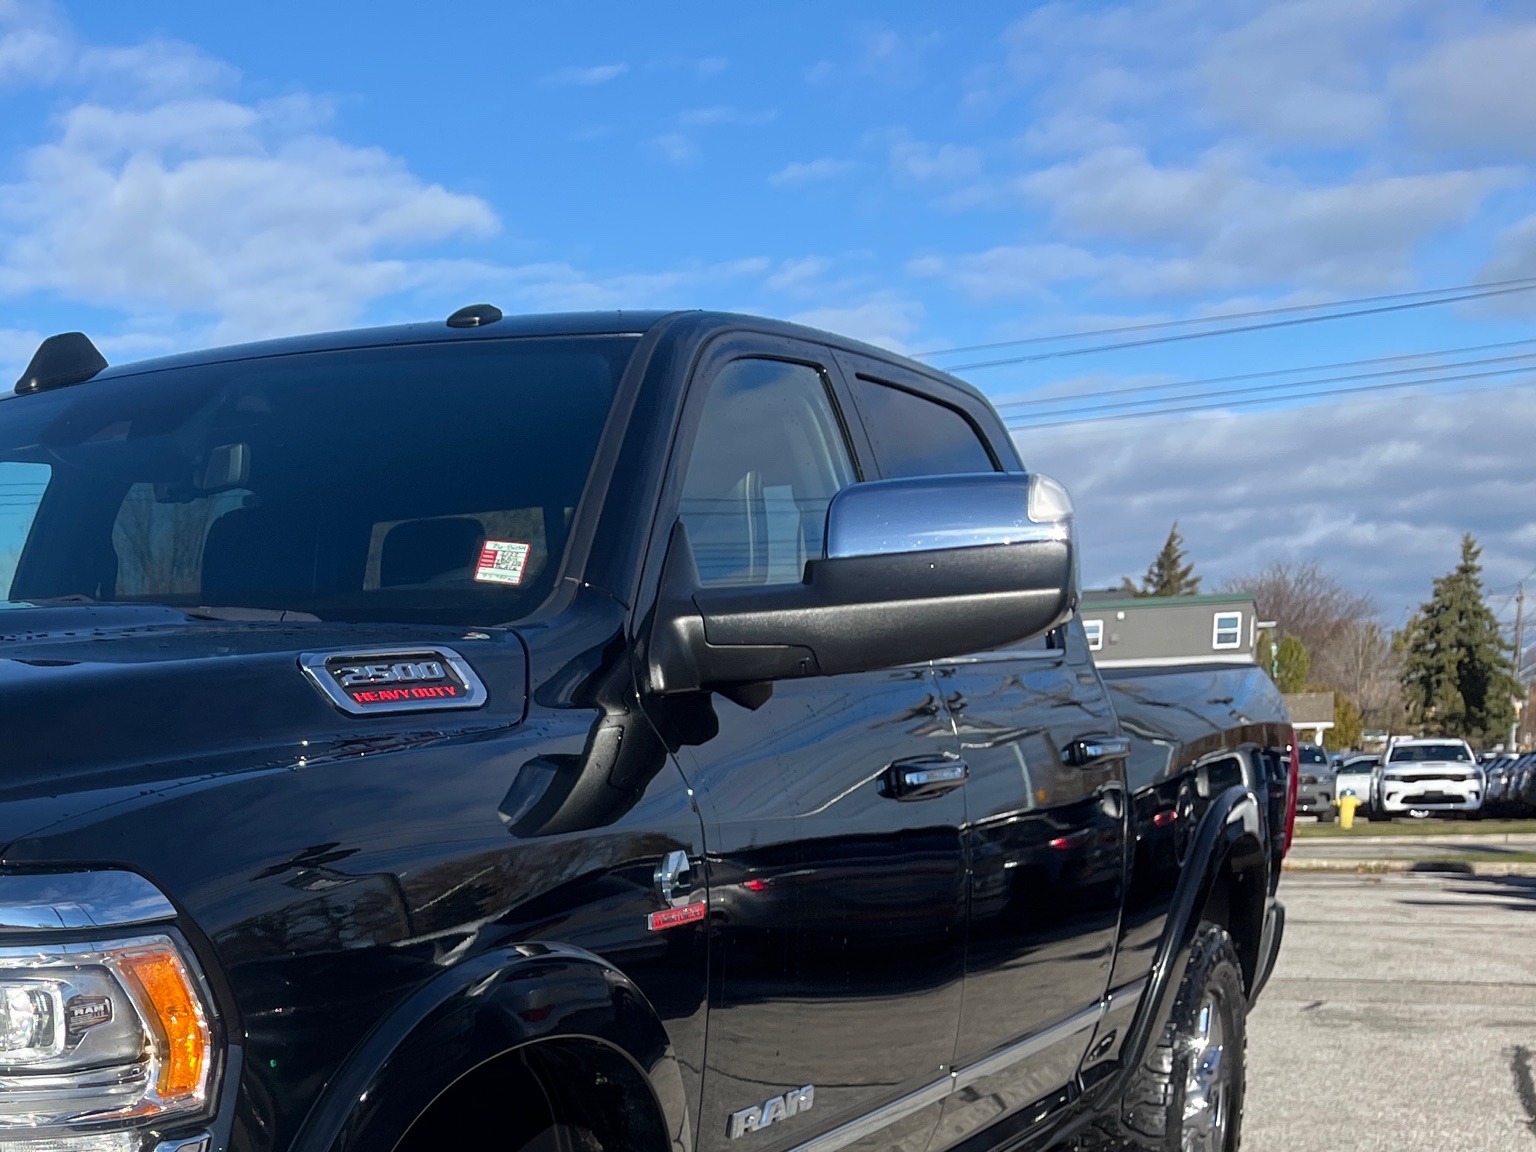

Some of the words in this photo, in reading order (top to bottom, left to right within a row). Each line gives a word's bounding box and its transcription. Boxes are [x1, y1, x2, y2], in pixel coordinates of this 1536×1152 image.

[334, 661, 445, 687] 2500
[353, 689, 410, 702] HEAVY
[411, 686, 456, 699] DUTY
[73, 1003, 105, 1017] RAM
[725, 1083, 815, 1140] RAM
